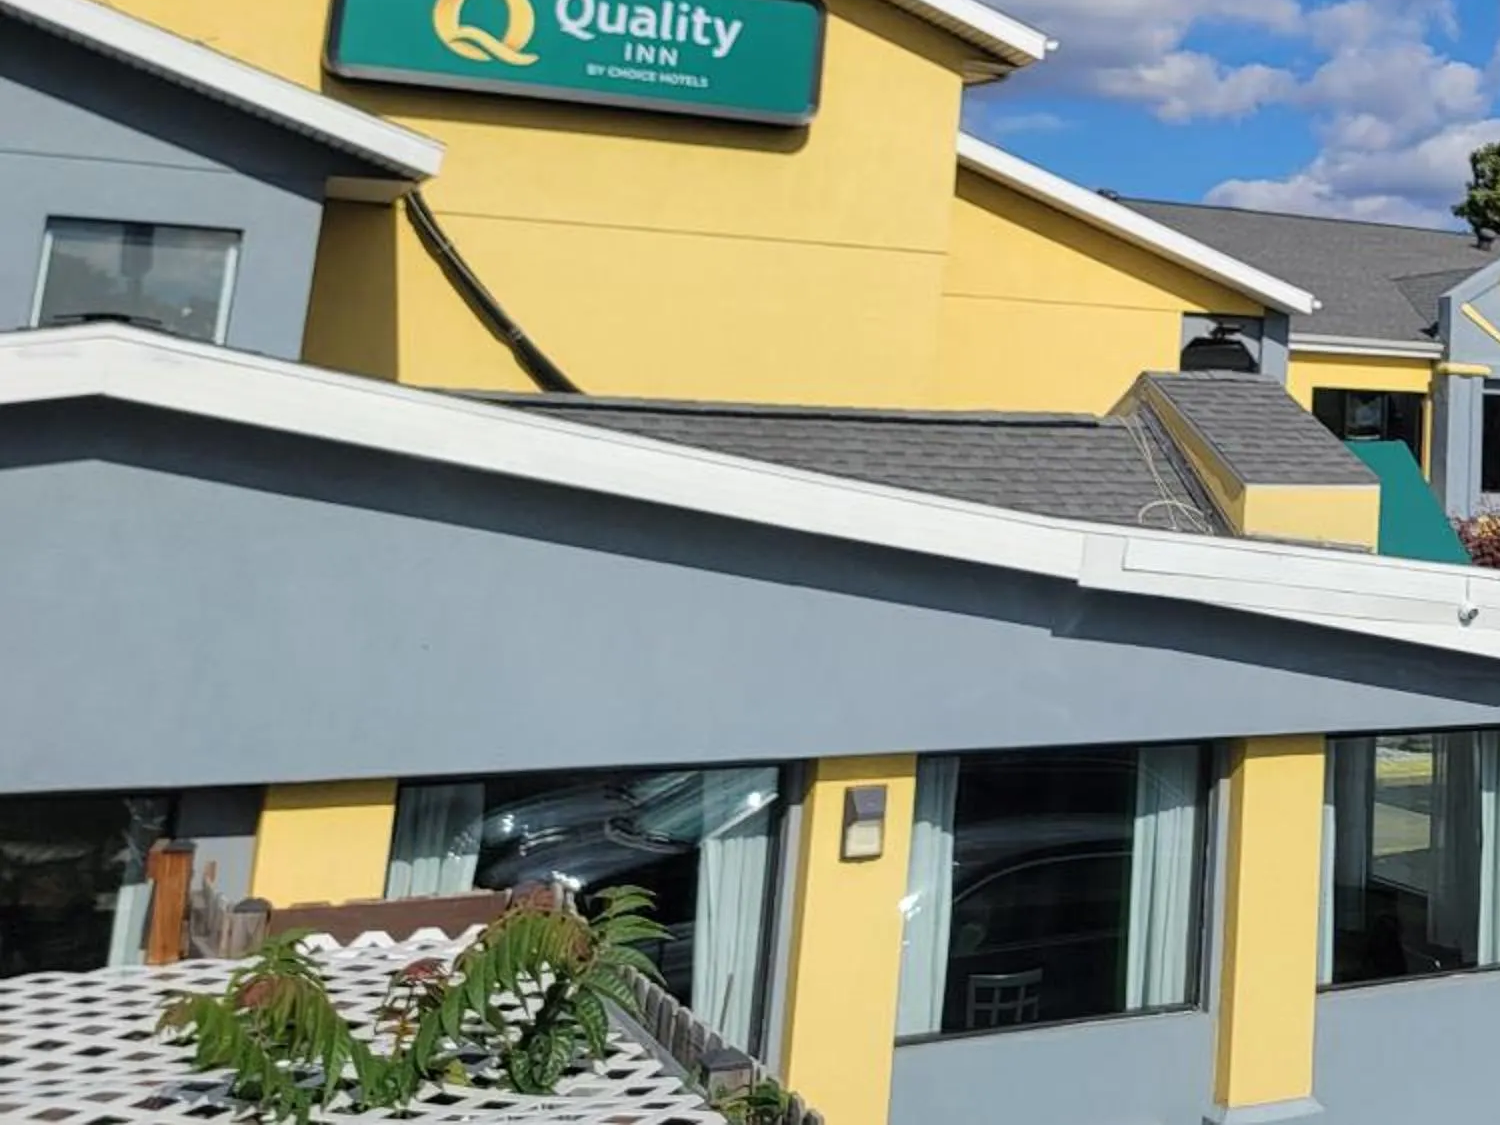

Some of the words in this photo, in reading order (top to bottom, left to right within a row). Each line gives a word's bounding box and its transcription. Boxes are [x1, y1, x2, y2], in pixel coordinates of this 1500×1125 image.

[624, 42, 678, 66] INN
[586, 63, 605, 76] BY
[607, 65, 656, 82] CHOICE
[659, 72, 709, 88] HOTELS
